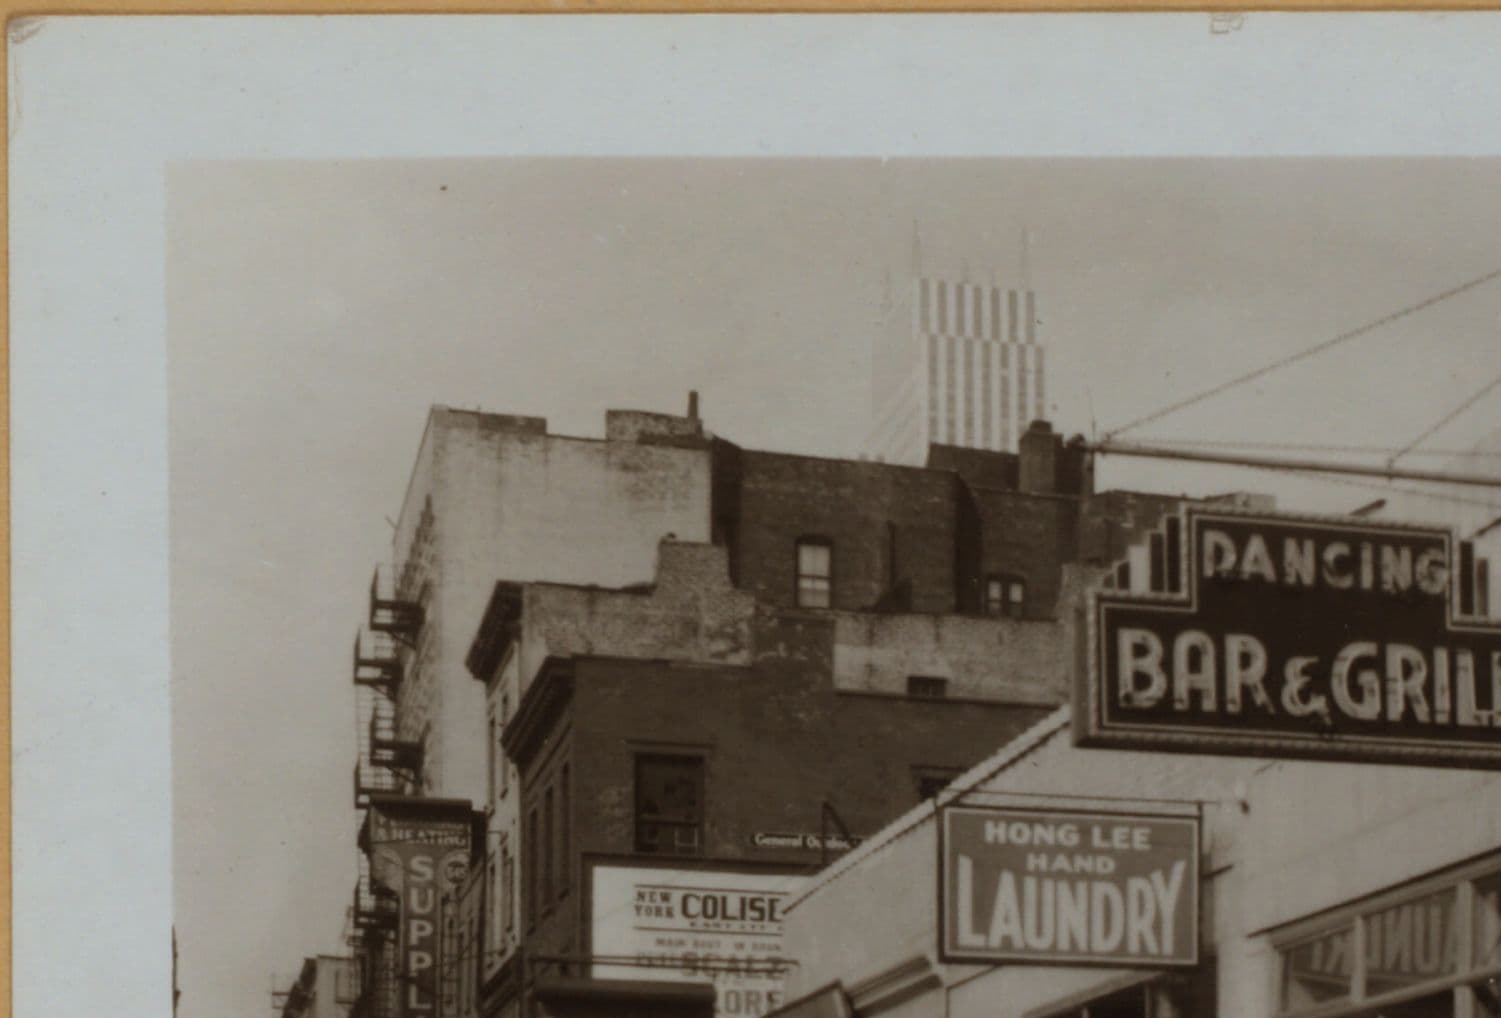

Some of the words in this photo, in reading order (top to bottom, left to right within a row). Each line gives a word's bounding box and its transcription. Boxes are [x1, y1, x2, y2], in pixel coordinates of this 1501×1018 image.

[1203, 529, 1449, 594] DANCING
[984, 820, 1080, 847] HONG
[1091, 826, 1152, 850] LEE
[1027, 853, 1116, 875] HAND
[636, 890, 673, 905] NEW
[957, 853, 1187, 957] LAUNDRY
[634, 903, 675, 919] YORK
